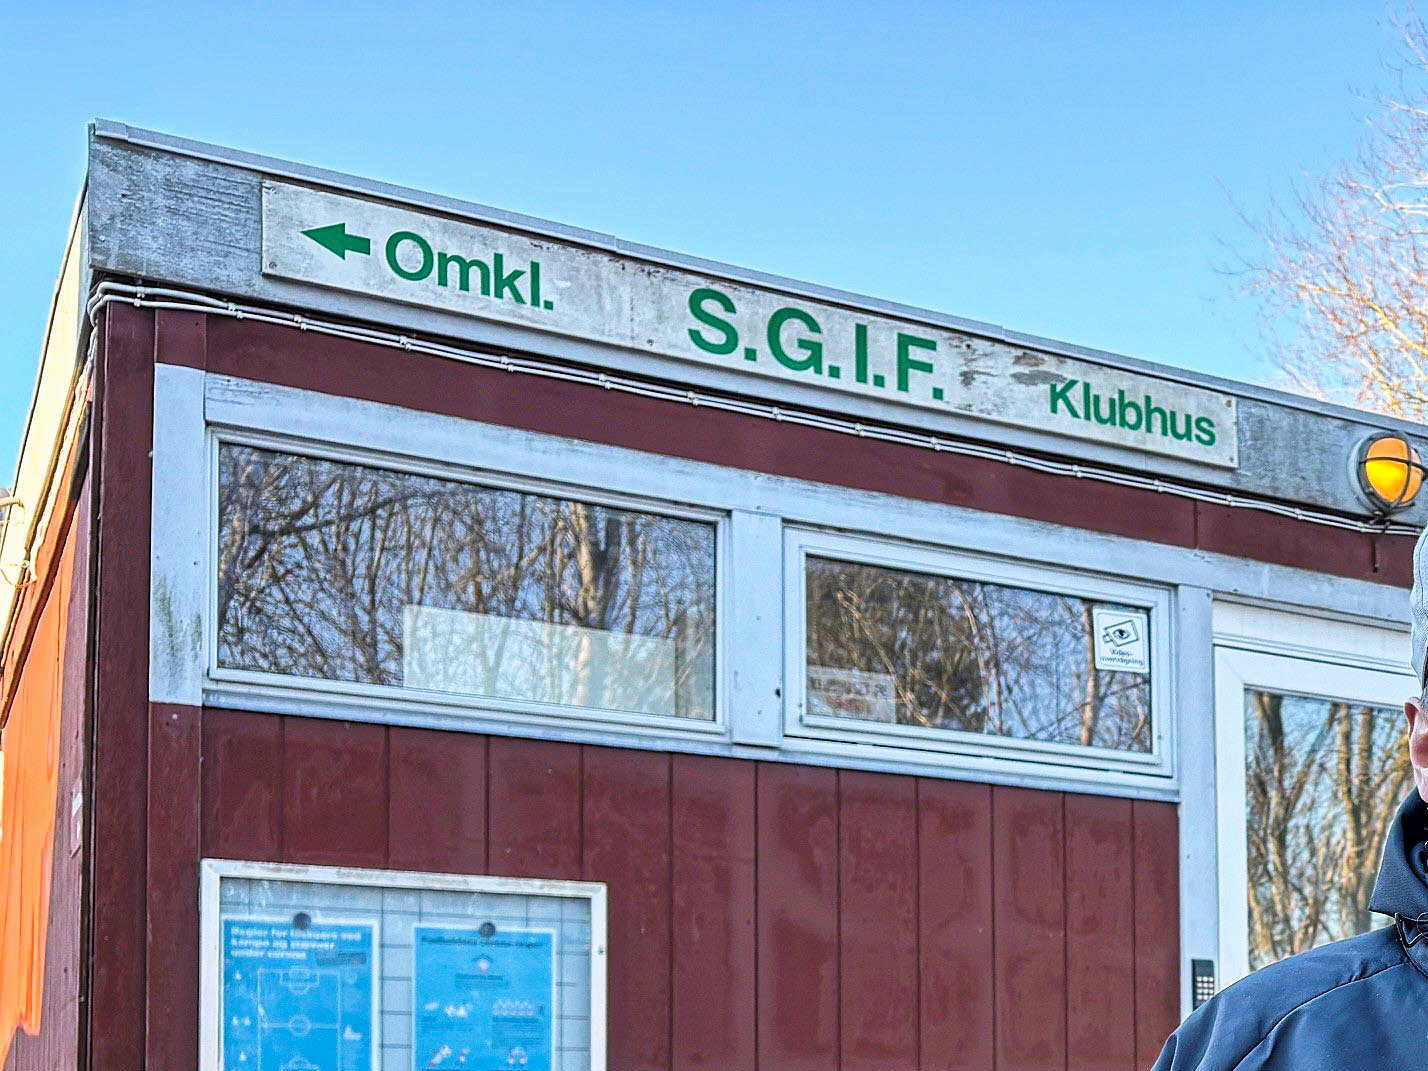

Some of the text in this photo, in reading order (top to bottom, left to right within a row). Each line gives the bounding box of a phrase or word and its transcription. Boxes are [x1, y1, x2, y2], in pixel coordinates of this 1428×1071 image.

[385, 231, 1216, 448] Omkl. S.G.I.F. Klubhus
